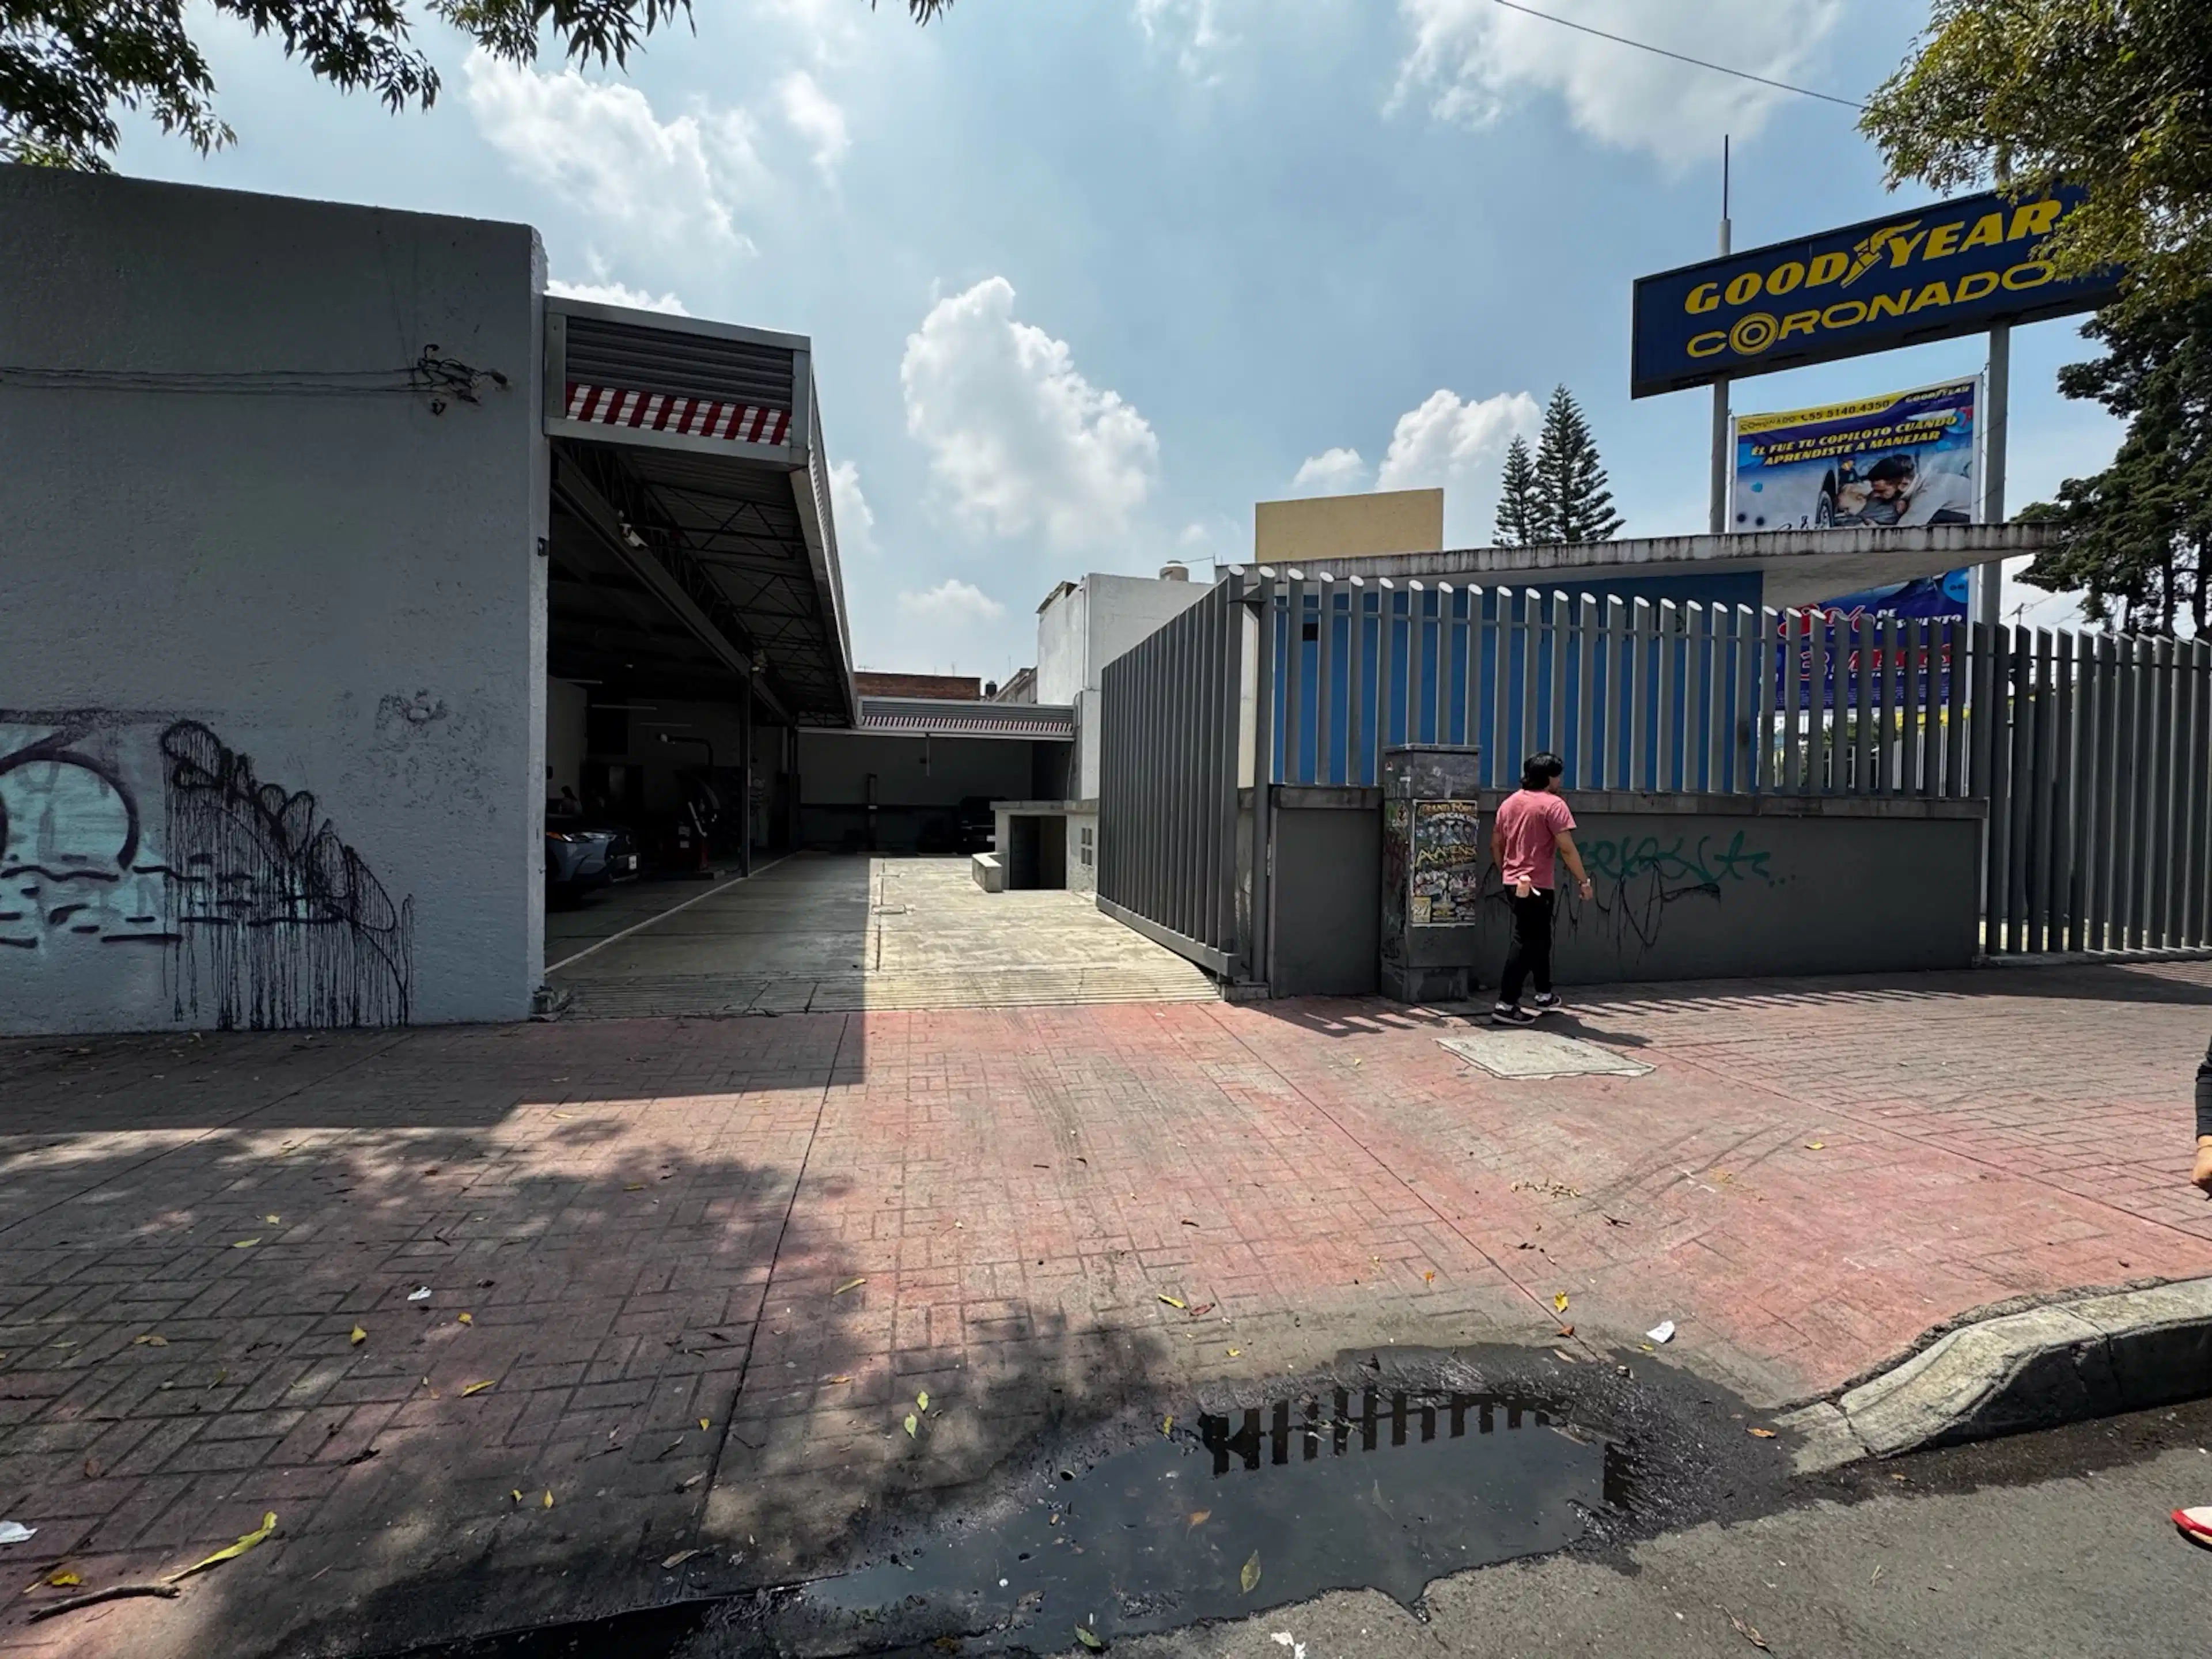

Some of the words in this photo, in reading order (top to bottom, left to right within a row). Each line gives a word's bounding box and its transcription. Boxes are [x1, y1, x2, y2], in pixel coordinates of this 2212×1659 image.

[1684, 199, 2062, 315] GOODYEAR
[1686, 260, 2055, 358] CORONADO
[1764, 443, 1853, 465] APRENDISTE
[1855, 441, 1866, 452] A
[1870, 430, 1940, 449] MANEJAR
[1769, 441, 1796, 453] FUE
[1798, 438, 1816, 449] TU
[1819, 426, 1892, 446] COPILOTO
[1895, 415, 1957, 433] CUANDO
